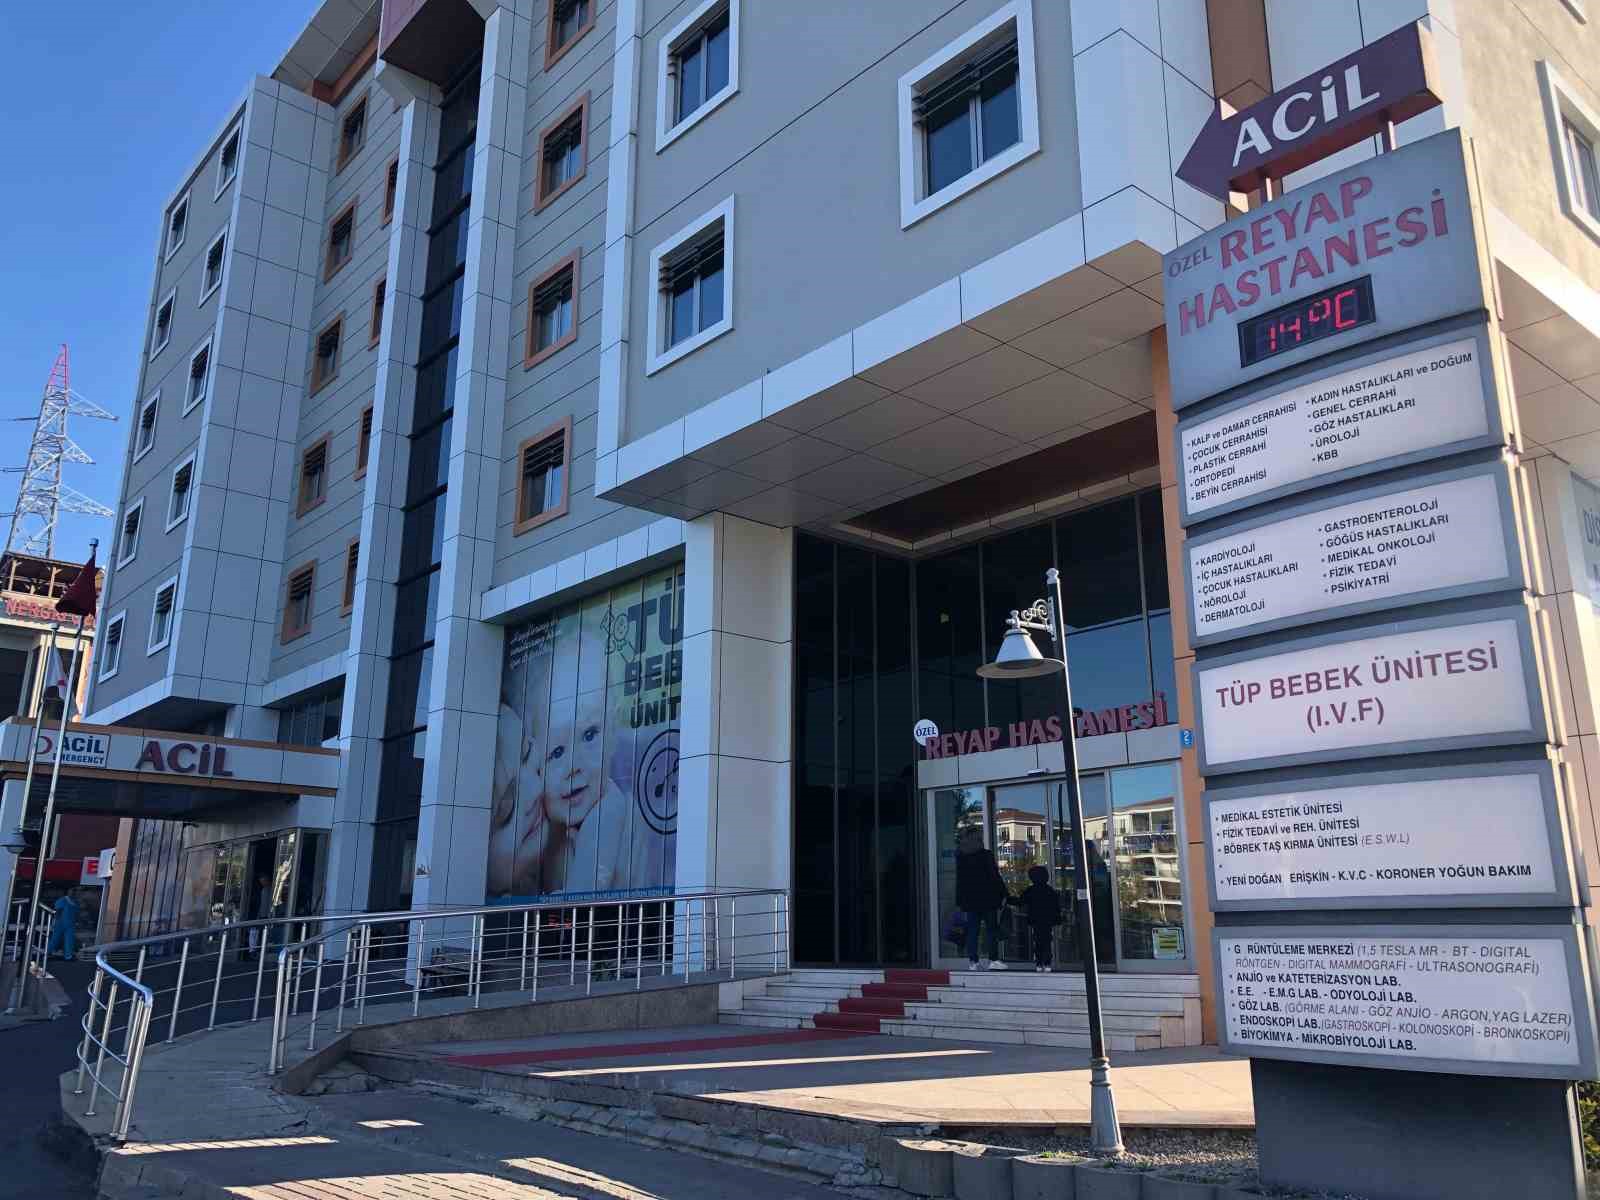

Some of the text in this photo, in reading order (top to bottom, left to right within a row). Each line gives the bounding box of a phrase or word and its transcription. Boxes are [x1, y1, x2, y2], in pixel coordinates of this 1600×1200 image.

[1168, 175, 1374, 279] ÖZEL REYAP
[1178, 189, 1449, 337] HASTANESİ
[1311, 352, 1473, 405] KADIN HASTALIKLARI ve DOĞUM
[1312, 386, 1397, 420] GENEL CERRAHİ
[1314, 398, 1416, 434] GÖZ HASTALIKLARI
[1191, 432, 1211, 447] KALP
[1212, 430, 1221, 439] ve
[1222, 418, 1250, 436] DAMAR
[1315, 426, 1360, 448] ÜROLOJİ
[1192, 443, 1220, 461] ÇOCUK
[1193, 440, 1267, 474] PLASTİK CERRAHİ
[1317, 449, 1338, 463] KBB
[1194, 464, 1236, 487] ORTOPEDİ
[1195, 485, 1219, 501] BEYİN
[1324, 496, 1439, 533] GASTROENTEROLOJİ
[1326, 513, 1449, 548] GÖĞÜS HASTALIKLARI
[1200, 540, 1256, 567] KARDİYOLOJİ
[1327, 531, 1436, 564] MEDİKAL ONKOLOJİ
[1211, 553, 1273, 577] HASTALIKLARI
[1357, 554, 1397, 573] TEDAVİ
[1203, 561, 1299, 595] ÇOCUK HASTALIKLARI
[1331, 571, 1390, 594] PSİKİYATRİ
[1203, 588, 1247, 609] NÖROLOJİ
[1205, 598, 1265, 623] DERMATOLOJİ
[1216, 640, 1499, 709] TÜP BEBEK ÜNİTESİ
[1306, 697, 1385, 734] (I.V.F)
[925, 725, 1000, 761] REYAP
[1221, 800, 1343, 823] MEDİKAL ESTETİK ÜNİTESİ
[1245, 823, 1279, 837] TEDAVİ
[1281, 825, 1291, 834] ve
[1293, 822, 1316, 833] REH.
[1319, 816, 1360, 831] ÜNİTESİ
[1224, 841, 1261, 855] BÖBREK
[1263, 840, 1282, 853] TAŞ
[1284, 838, 1315, 850] KIRMA
[1317, 834, 1358, 848] ÜNİTESİ
[1226, 873, 1247, 886] YENİ
[1248, 871, 1282, 885] DOĞAN
[1290, 871, 1329, 885] ERİŞKİN
[1338, 869, 1367, 881] K.V.C
[1376, 867, 1436, 880] KORONER
[1438, 864, 1485, 878] YOĞUN
[1488, 864, 1532, 877] BAKIM
[1307, 942, 1354, 955] MERKEZİ
[1380, 945, 1416, 956] TESLA
[1419, 945, 1439, 956] MR
[1452, 946, 1469, 957] BT
[1235, 956, 1280, 969] RÖNTGEN
[1329, 957, 1407, 971] MAMMOGRAFİ
[1266, 975, 1276, 983] ve
[1278, 971, 1371, 986] KATETERİZASYON
[1374, 975, 1401, 987] LAB.
[1269, 988, 1296, 998] E.M.G
[1298, 988, 1322, 999] LAB.
[1330, 988, 1387, 1002] ODYOLOJİ
[1389, 992, 1417, 1003] LAB.
[1238, 999, 1257, 1011] GÖZ
[1260, 1001, 1282, 1012] LAB.
[1328, 1004, 1359, 1015] ALANI
[1368, 1004, 1393, 1017] GÖZ
[1523, 1012, 1572, 1026] LAZER)
[1241, 1028, 1293, 1042] BİYOKİMYA
[1301, 1032, 1387, 1049] MİKROBİYOLOJİ
[1389, 1039, 1417, 1051] LAB.
[1399, 1023, 1475, 1037] KOLONOSKOPİ
